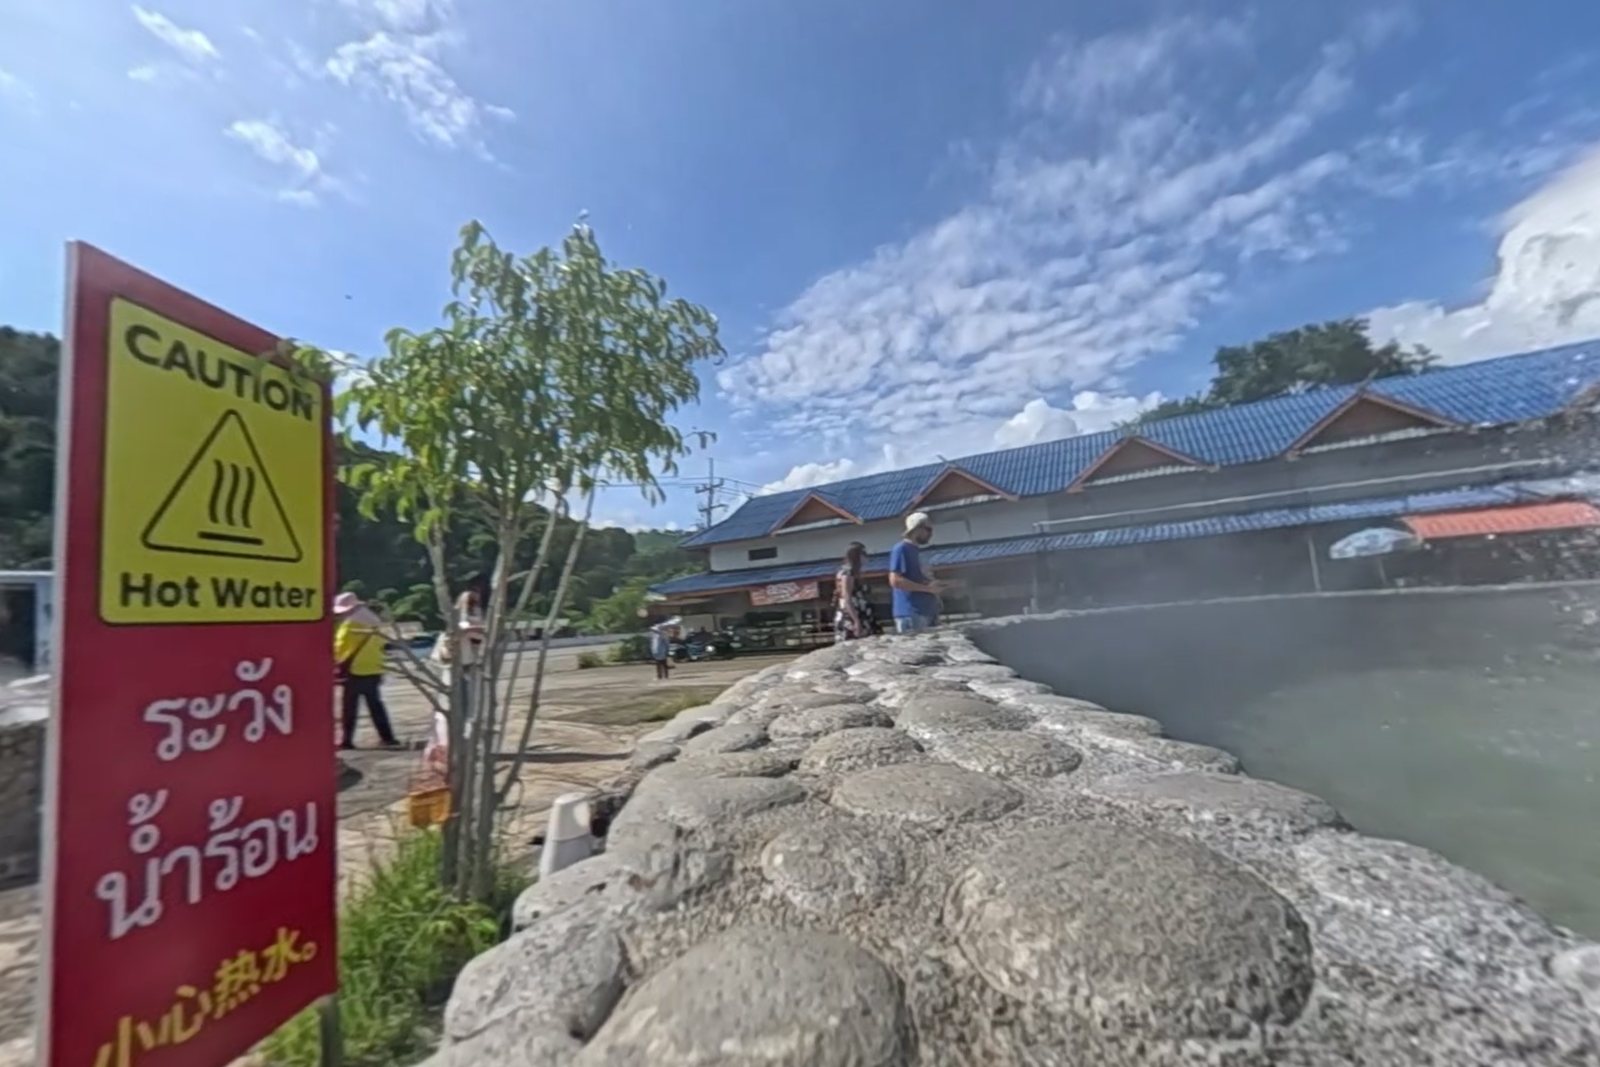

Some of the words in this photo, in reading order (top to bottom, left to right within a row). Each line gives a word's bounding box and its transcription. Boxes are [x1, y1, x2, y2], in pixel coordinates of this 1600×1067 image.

[125, 325, 313, 421] CAUTION
[120, 573, 200, 608] Hot
[213, 578, 316, 608] Water
[144, 657, 292, 761] ระวัง
[96, 789, 318, 939] น้ำร้อน
